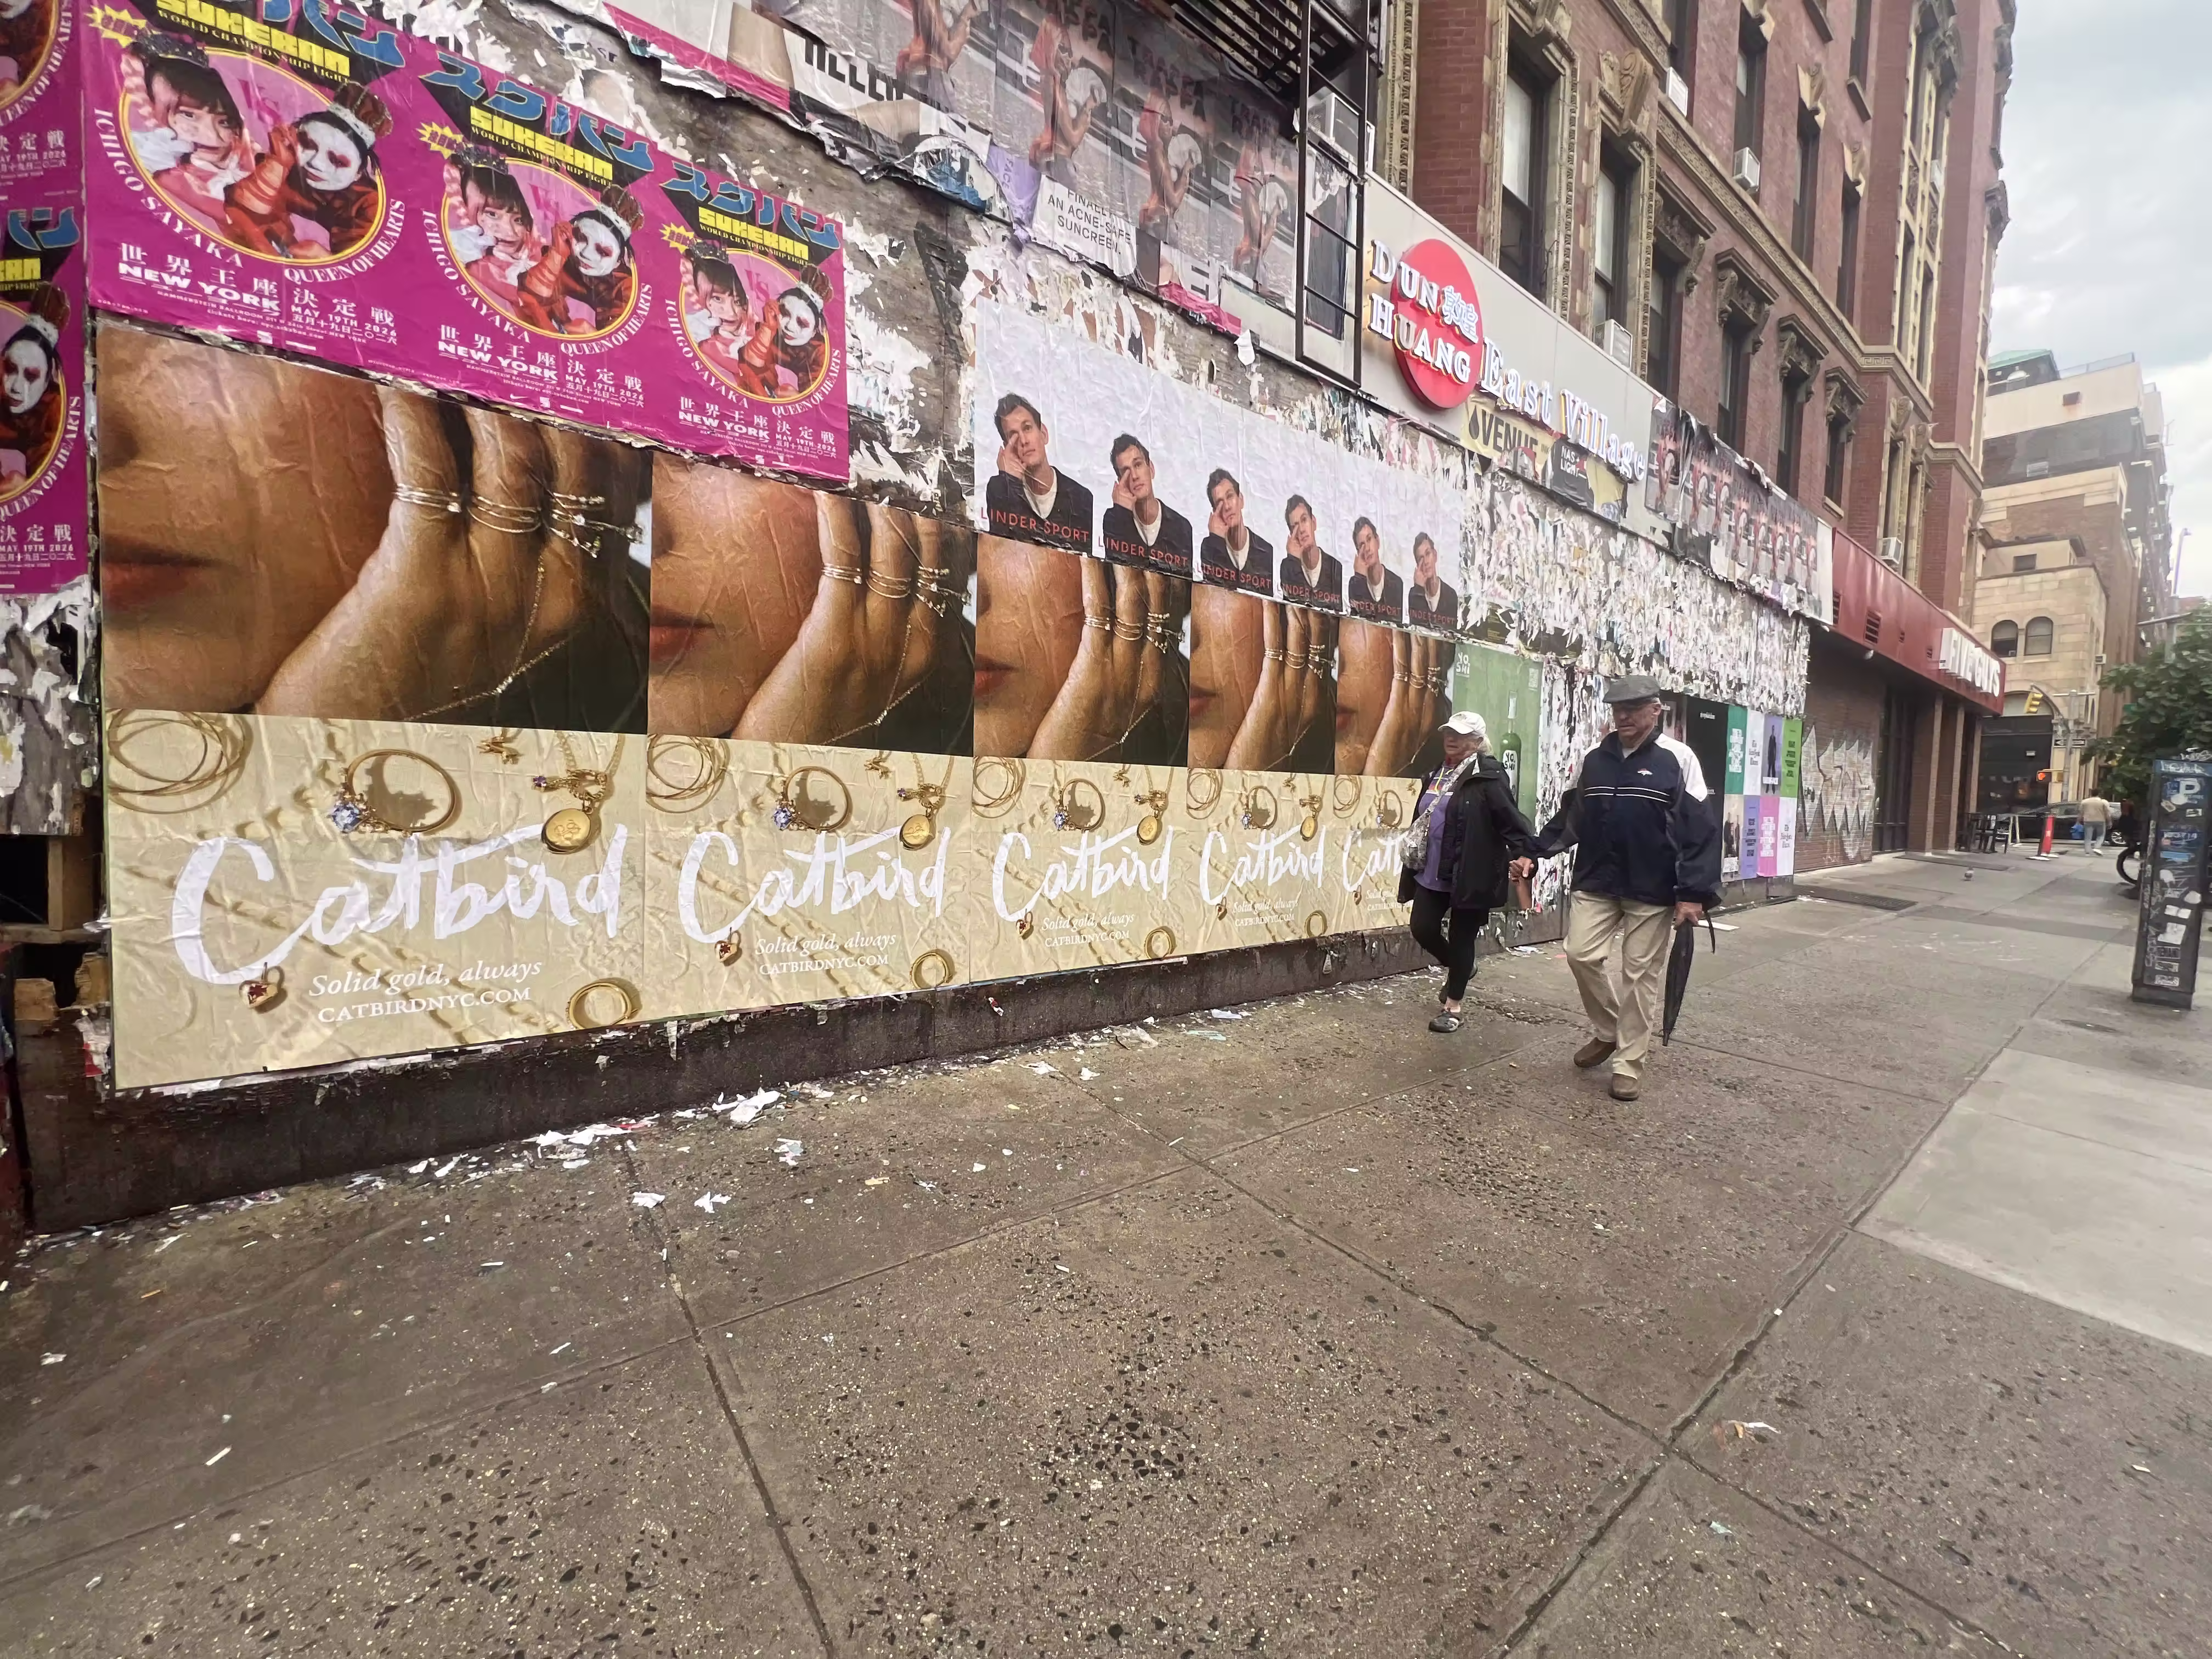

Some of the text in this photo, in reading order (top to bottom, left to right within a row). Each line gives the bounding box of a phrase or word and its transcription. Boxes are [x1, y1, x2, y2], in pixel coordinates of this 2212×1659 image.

[158, 10, 208, 34] WORLD
[471, 126, 510, 146] WORLD
[94, 108, 144, 191] ICHIGO
[141, 196, 244, 268] SAYAKA
[700, 223, 729, 239] WORLD
[1047, 194, 1131, 245] AN ACNE-SAFE
[284, 199, 405, 285] QUEEN OF HEARTS
[119, 263, 281, 312] NEW YORK
[422, 210, 459, 280] ICHIGO
[455, 284, 531, 343] SAYAKA
[1370, 240, 1439, 315] DUN
[291, 304, 397, 337] MAY 19TH 2026
[560, 283, 652, 357] QUEEN OF HEARTS
[1440, 285, 1479, 344] 敦煌
[665, 299, 748, 409] ICHIGO SAYAKA
[1368, 294, 1470, 383] HUANG
[438, 341, 558, 381] NEW YORK
[565, 374, 644, 400] MAY 19TH 2026
[771, 348, 841, 418] QUEEN OF HEARTS
[679, 410, 719, 428] NEW
[724, 420, 770, 438] YORK
[1481, 336, 1645, 482] East Village
[775, 433, 837, 453] MAY 19TH 2026
[981, 507, 1090, 543] LINDER SPORT
[49, 544, 74, 552] 2026
[1098, 535, 1189, 567] LINDER SPORT
[1240, 573, 1271, 589] SPORT
[1313, 590, 1341, 603] SPORT
[992, 825, 1175, 922] Catbird
[1199, 823, 1326, 906] Catbird
[1342, 829, 1408, 893] Catb
[172, 823, 628, 985] Catbird
[678, 826, 951, 944] Catbird
[1042, 911, 1135, 932] Solid gold, always
[1044, 930, 1130, 947] CATBIRDNYC.COM
[755, 931, 897, 957] Solid gold, always
[308, 957, 543, 997] Solid gold, always
[759, 954, 889, 975] CATBIRDNYC.COM
[317, 986, 532, 1023] CATBIRDNYC.COM
